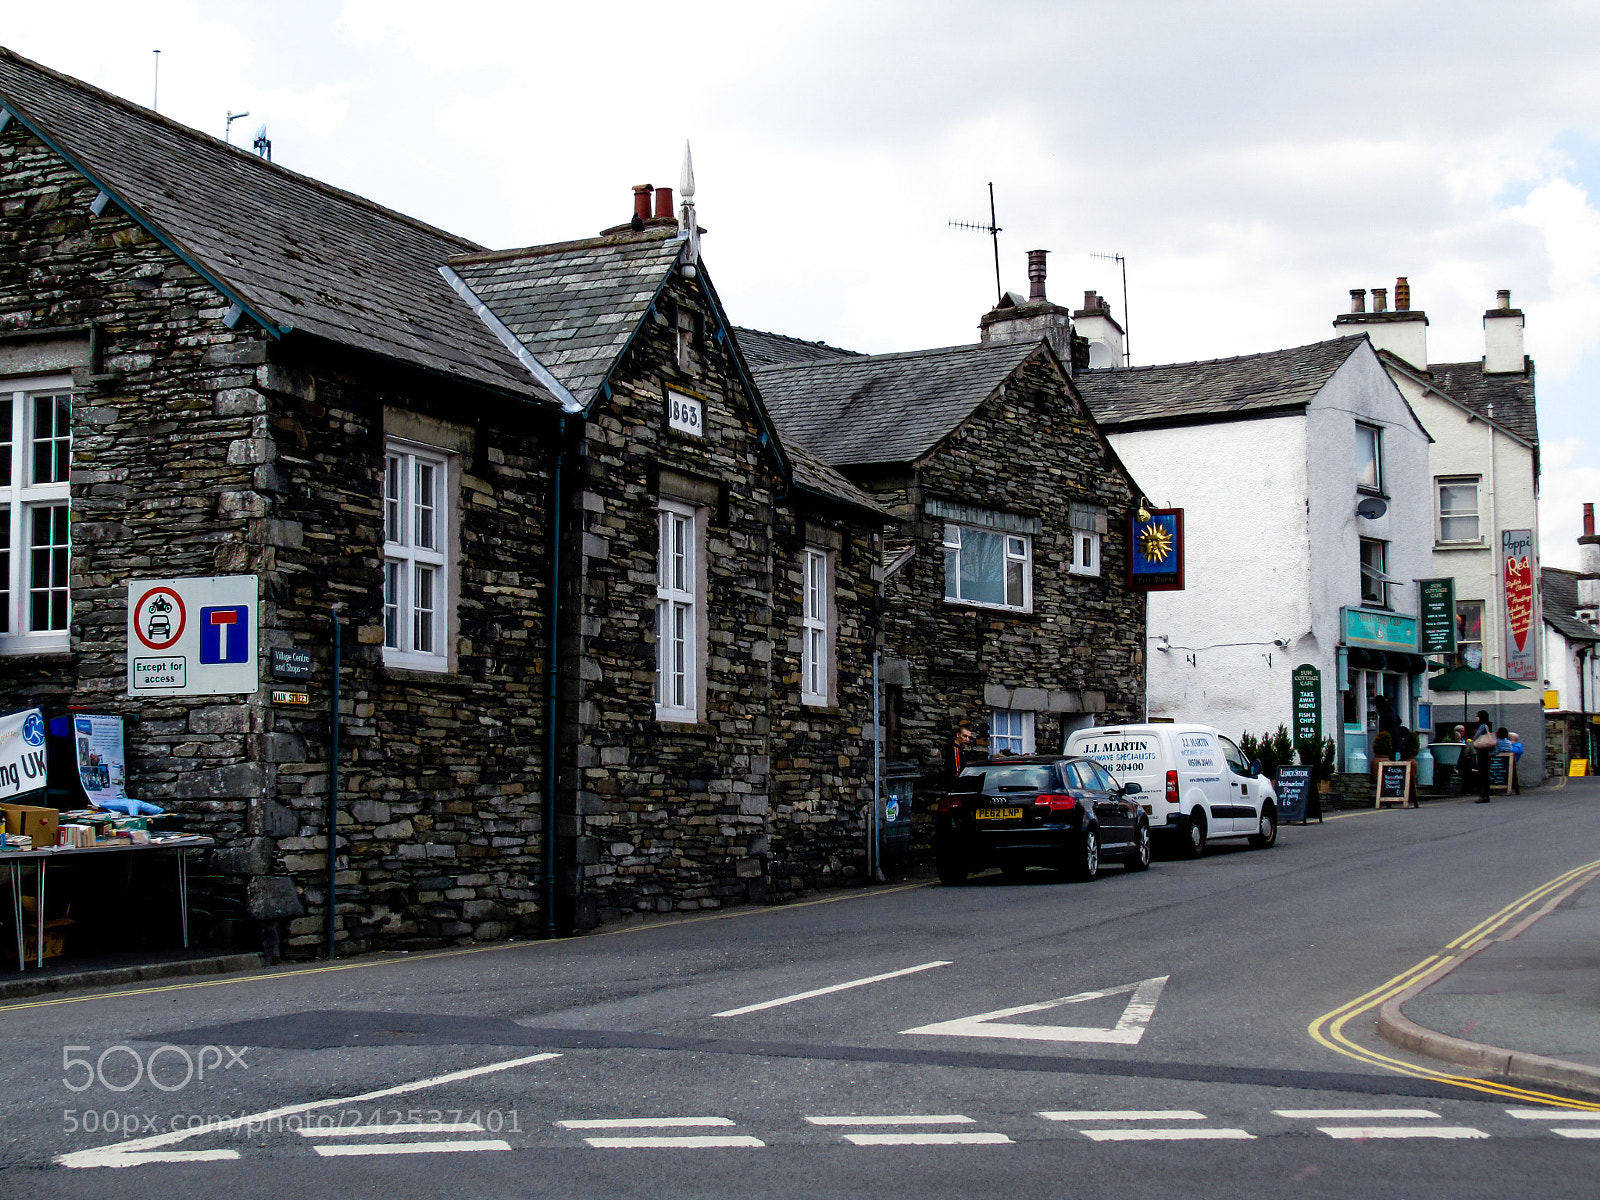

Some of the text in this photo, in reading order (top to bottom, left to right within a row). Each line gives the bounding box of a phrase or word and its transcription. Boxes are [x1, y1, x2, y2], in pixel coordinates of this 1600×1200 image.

[1502, 530, 1532, 555] Poppi
[1508, 556, 1530, 576] Red
[275, 650, 310, 663] Village Centre
[137, 661, 182, 673] Except for
[275, 663, 301, 675] and Shops
[145, 676, 175, 684] access
[1083, 741, 1147, 754] J.J. MARTIN
[1117, 752, 1156, 762] SPECIALISTS
[21, 749, 47, 779] UK
[1116, 762, 1144, 772] 20400
[979, 808, 1020, 818] PE62 LNP
